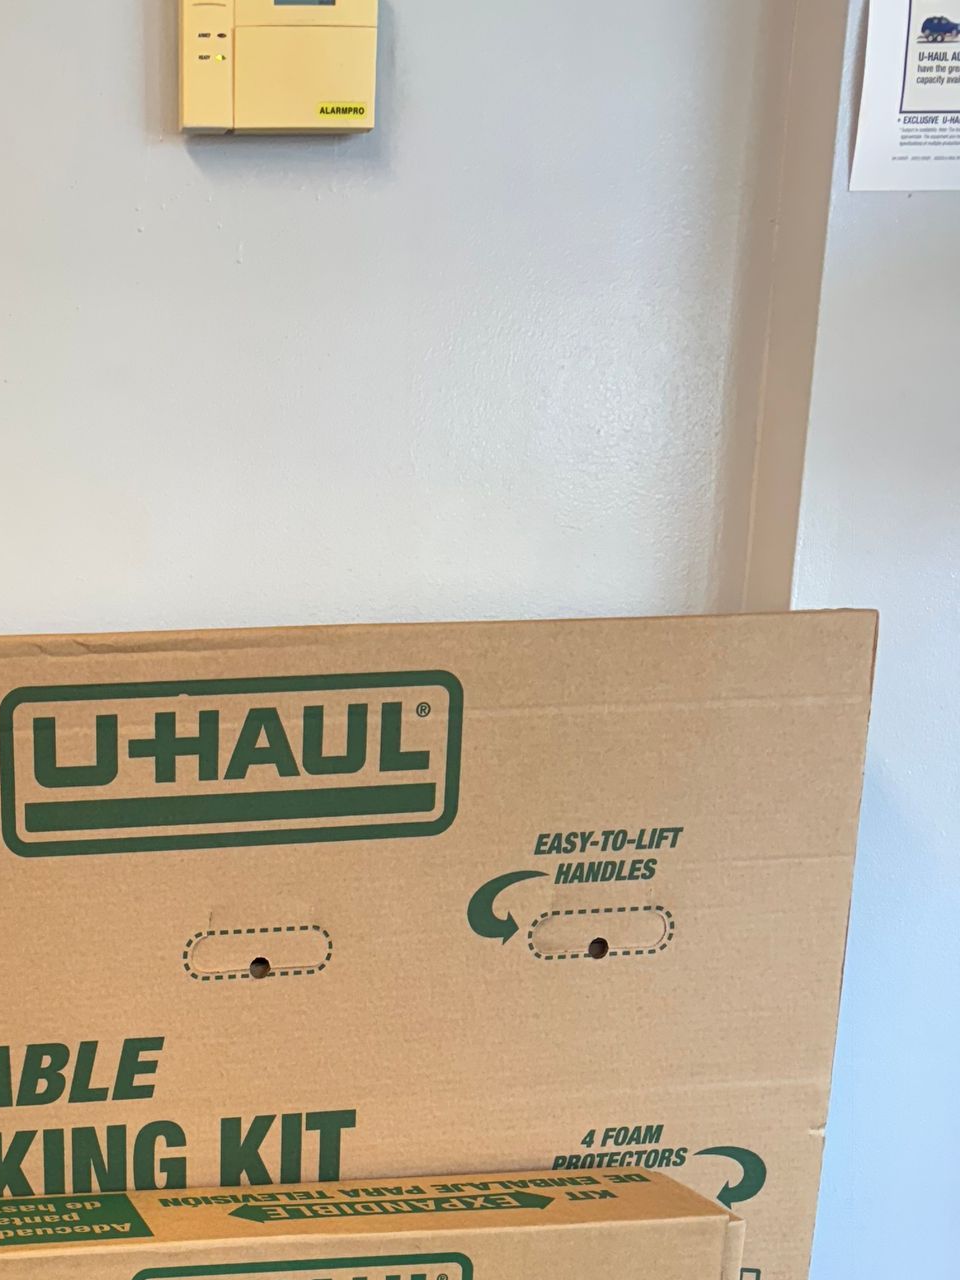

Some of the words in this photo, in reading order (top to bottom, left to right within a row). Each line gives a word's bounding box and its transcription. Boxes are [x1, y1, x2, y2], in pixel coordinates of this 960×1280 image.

[918, 52, 949, 62] U-HAUL
[917, 65, 934, 73] have
[935, 64, 946, 72] the
[916, 76, 945, 85] capacity
[319, 106, 365, 116] ALARMPRO
[903, 116, 939, 124] EXCLUSIVE
[533, 827, 684, 856] EASY-TO-LIFT
[554, 858, 657, 885] HANDLES
[580, 1129, 596, 1149] 4
[600, 1124, 665, 1147] FOAM
[219, 1108, 357, 1188] KIT
[551, 1147, 689, 1171] PROTECTORS
[430, 1175, 602, 1194] EMBALAJE
[603, 1173, 652, 1184] DE
[337, 1184, 426, 1198] PARA
[565, 1189, 619, 1201] KIT
[65, 1200, 102, 1211] de
[267, 1193, 522, 1219] EXPANDIBLE
